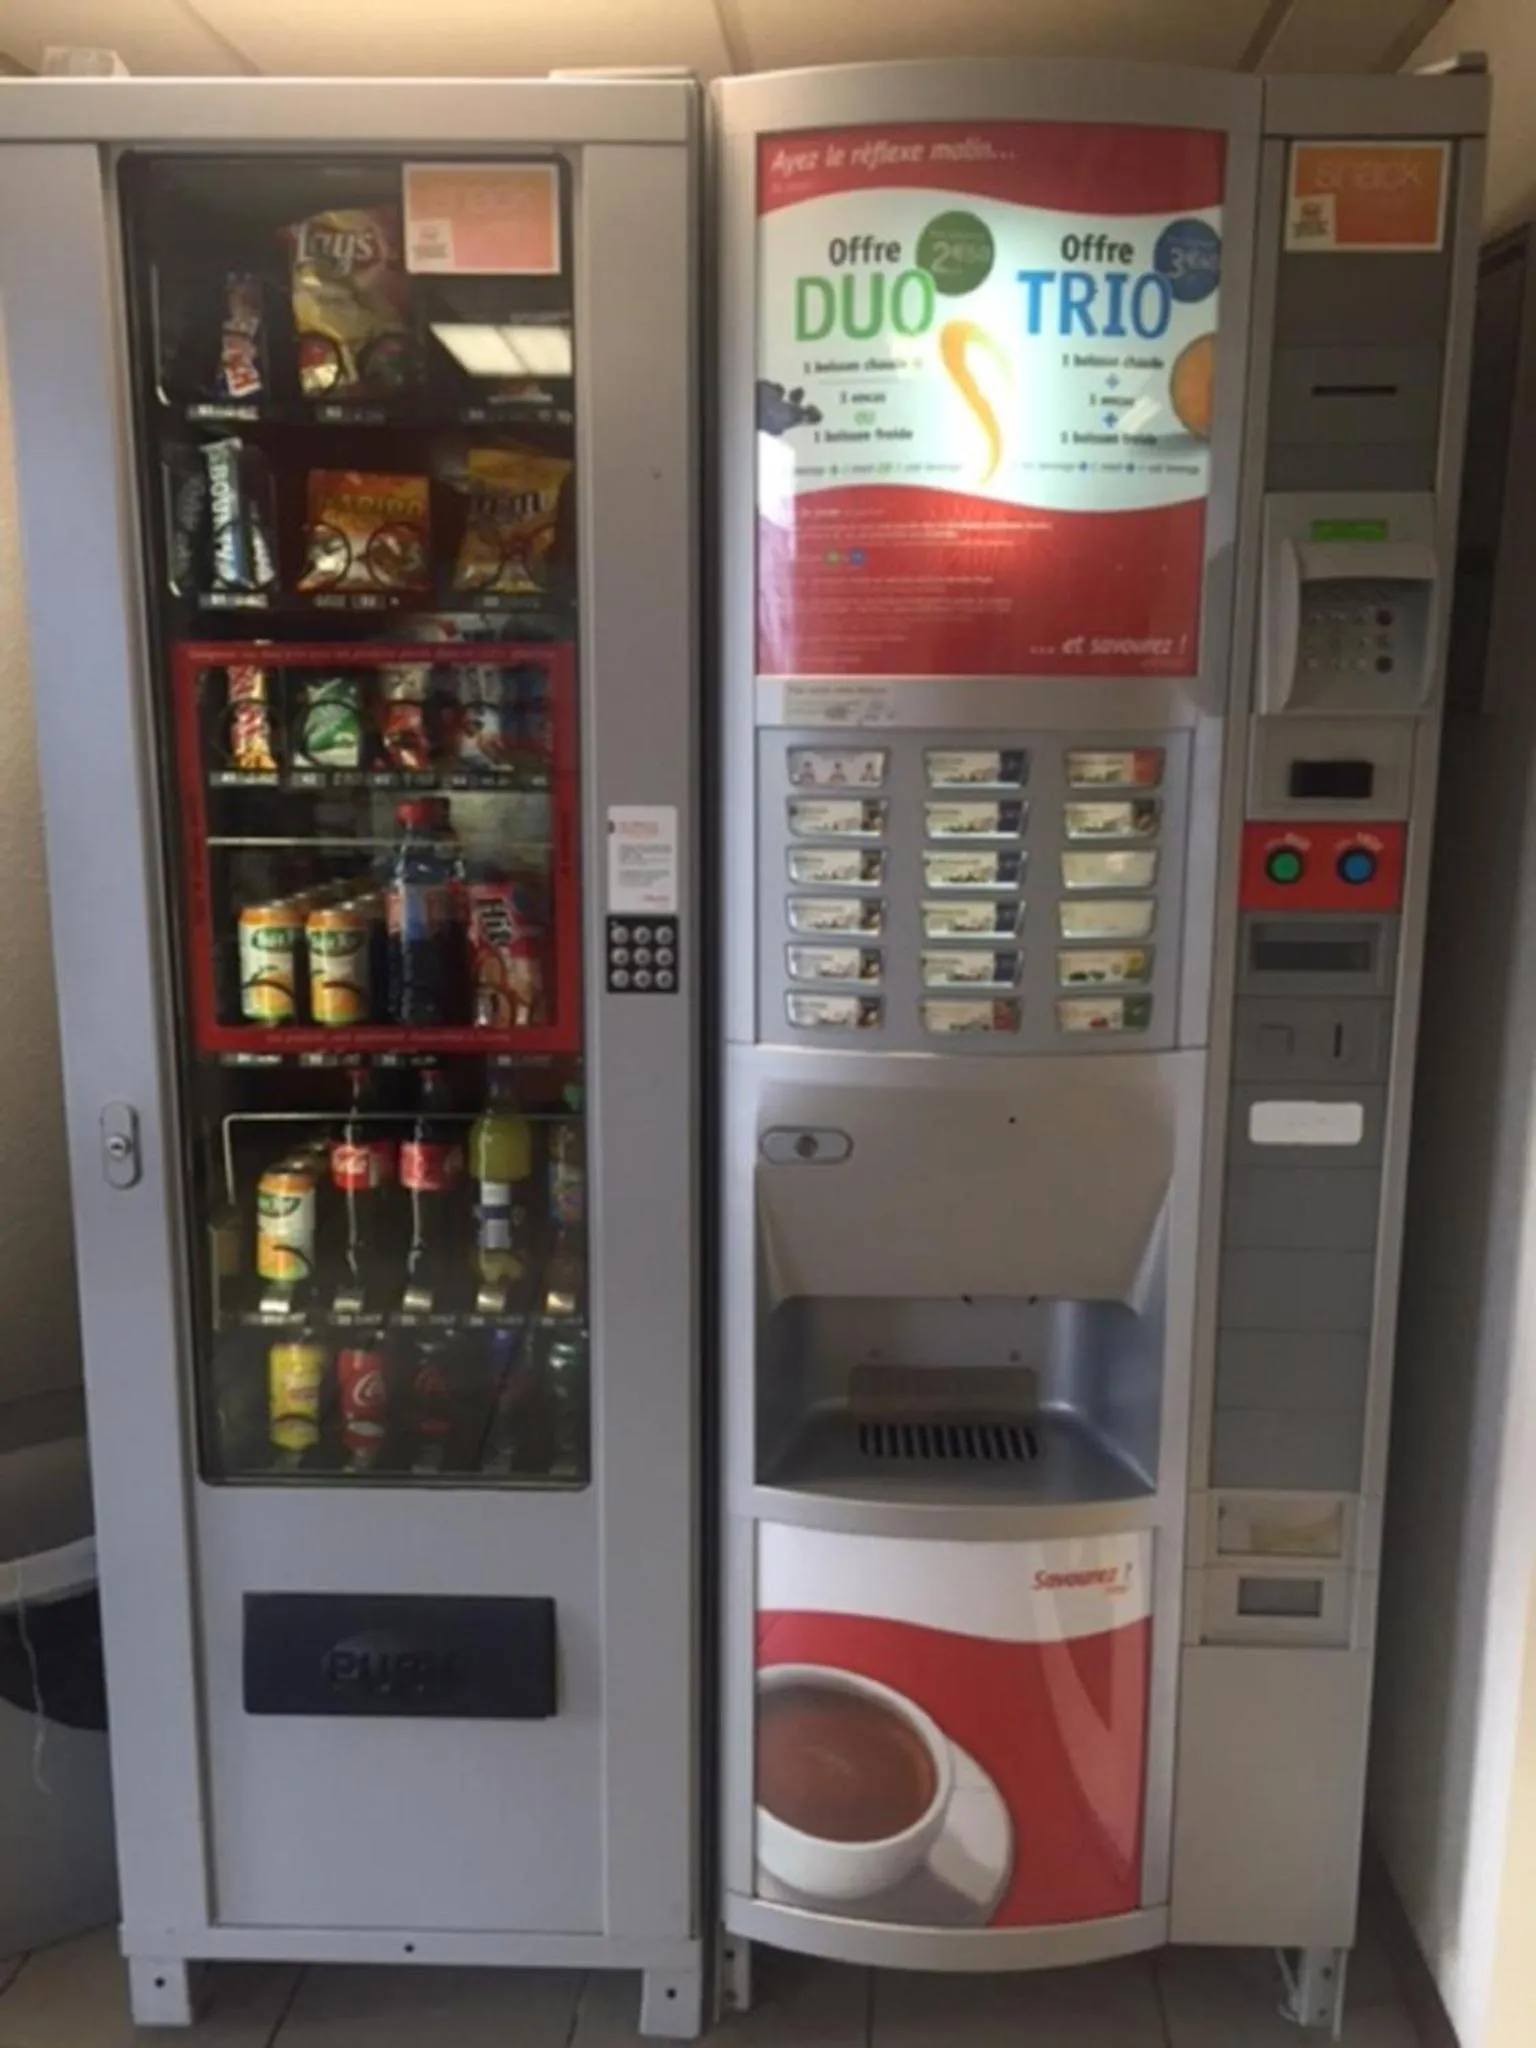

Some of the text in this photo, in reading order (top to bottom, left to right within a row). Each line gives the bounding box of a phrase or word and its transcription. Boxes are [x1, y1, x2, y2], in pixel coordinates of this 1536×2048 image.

[771, 149, 819, 177] Ayez
[825, 143, 846, 168] le
[851, 139, 925, 171] réflexe
[829, 235, 901, 266] Offre
[1061, 234, 1135, 264] Offre
[795, 268, 935, 341] DUO
[1017, 270, 1172, 339] TRIO
[1032, 1568, 1117, 1590] Savourez
